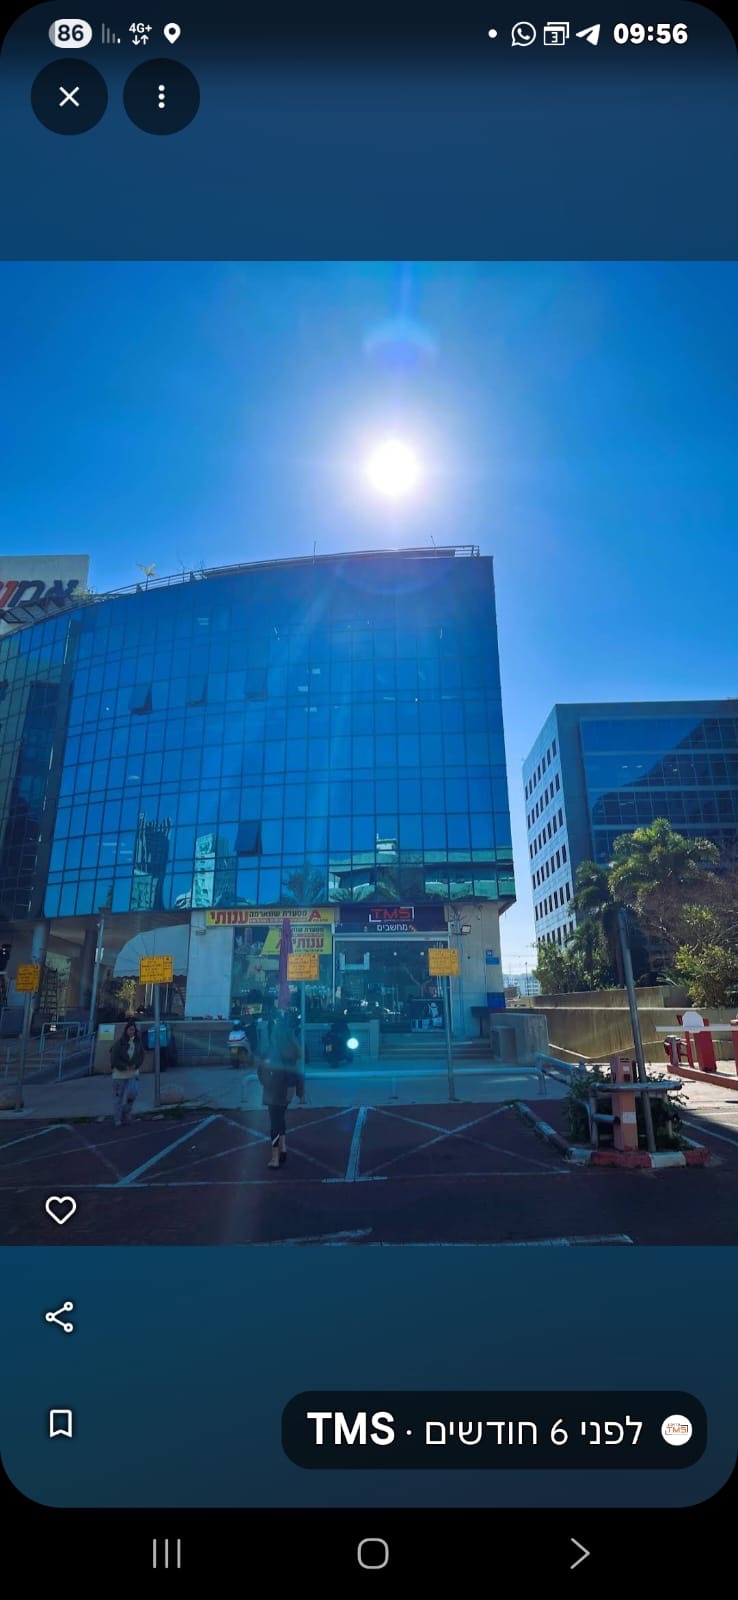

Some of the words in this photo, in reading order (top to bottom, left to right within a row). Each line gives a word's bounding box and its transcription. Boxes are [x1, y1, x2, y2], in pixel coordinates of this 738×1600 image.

[210, 911, 248, 924] ענותי
[370, 907, 411, 919] TMS
[376, 924, 408, 932] מחשבים
